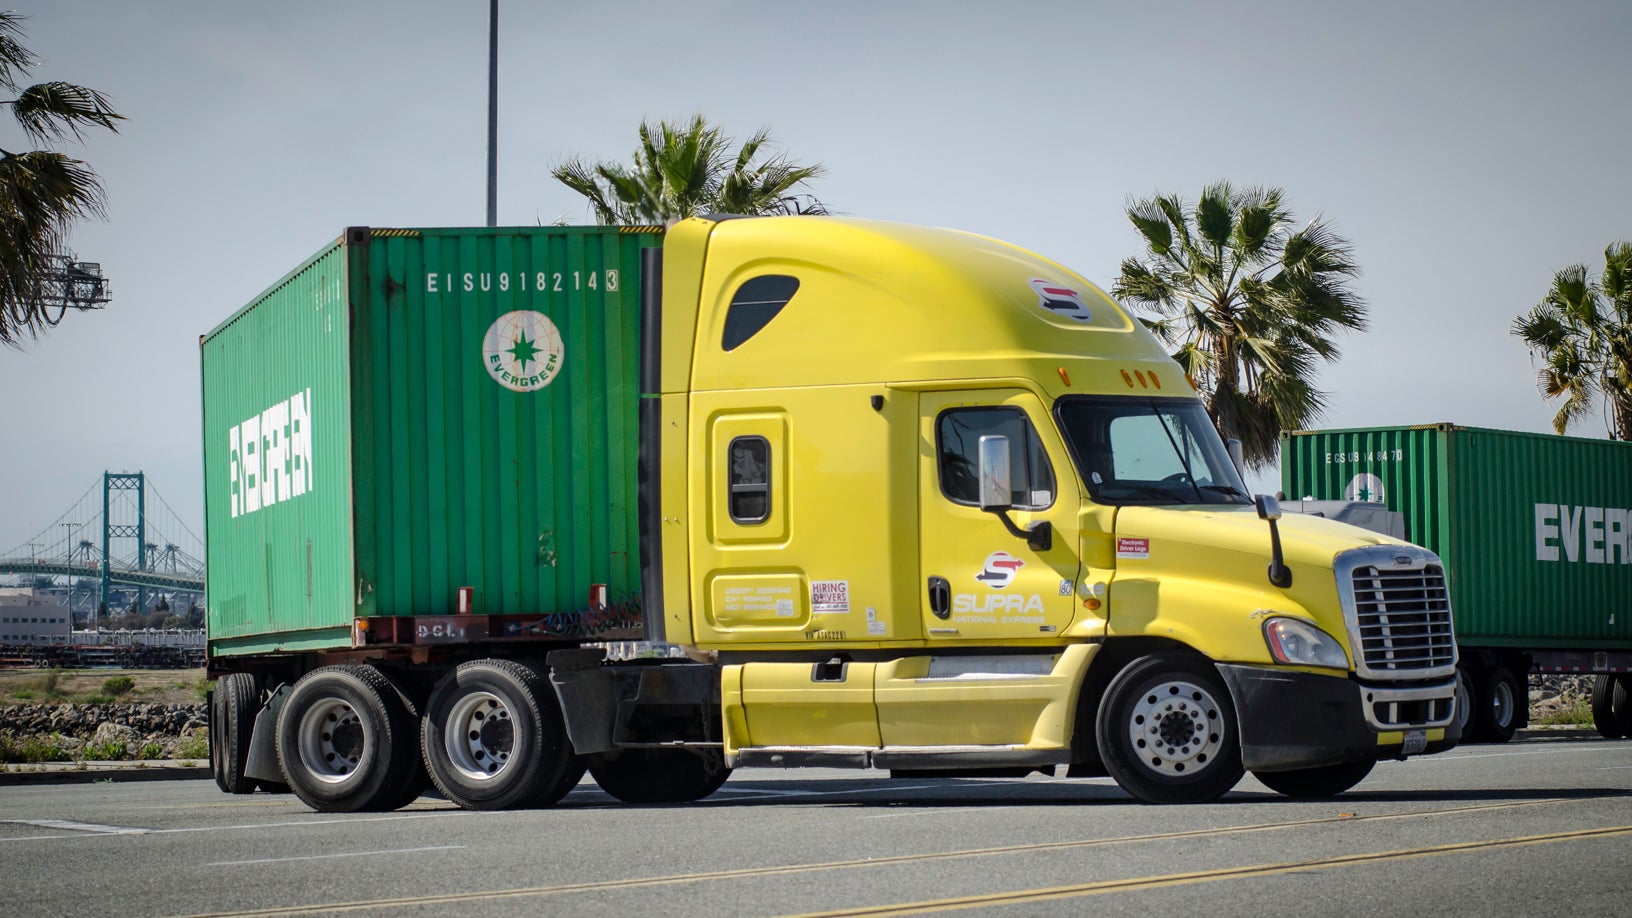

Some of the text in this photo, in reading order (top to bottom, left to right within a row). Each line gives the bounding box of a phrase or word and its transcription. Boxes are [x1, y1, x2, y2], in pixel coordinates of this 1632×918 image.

[489, 353, 558, 387] EVERGREEN
[229, 387, 313, 519] EVERGREEN
[1534, 503, 1632, 565] EVER
[812, 582, 846, 593] HIRING
[813, 593, 847, 602] DRIVERS
[953, 593, 1044, 614] SUPRA
[953, 615, 1046, 624] NATIONAL EXPRESS
